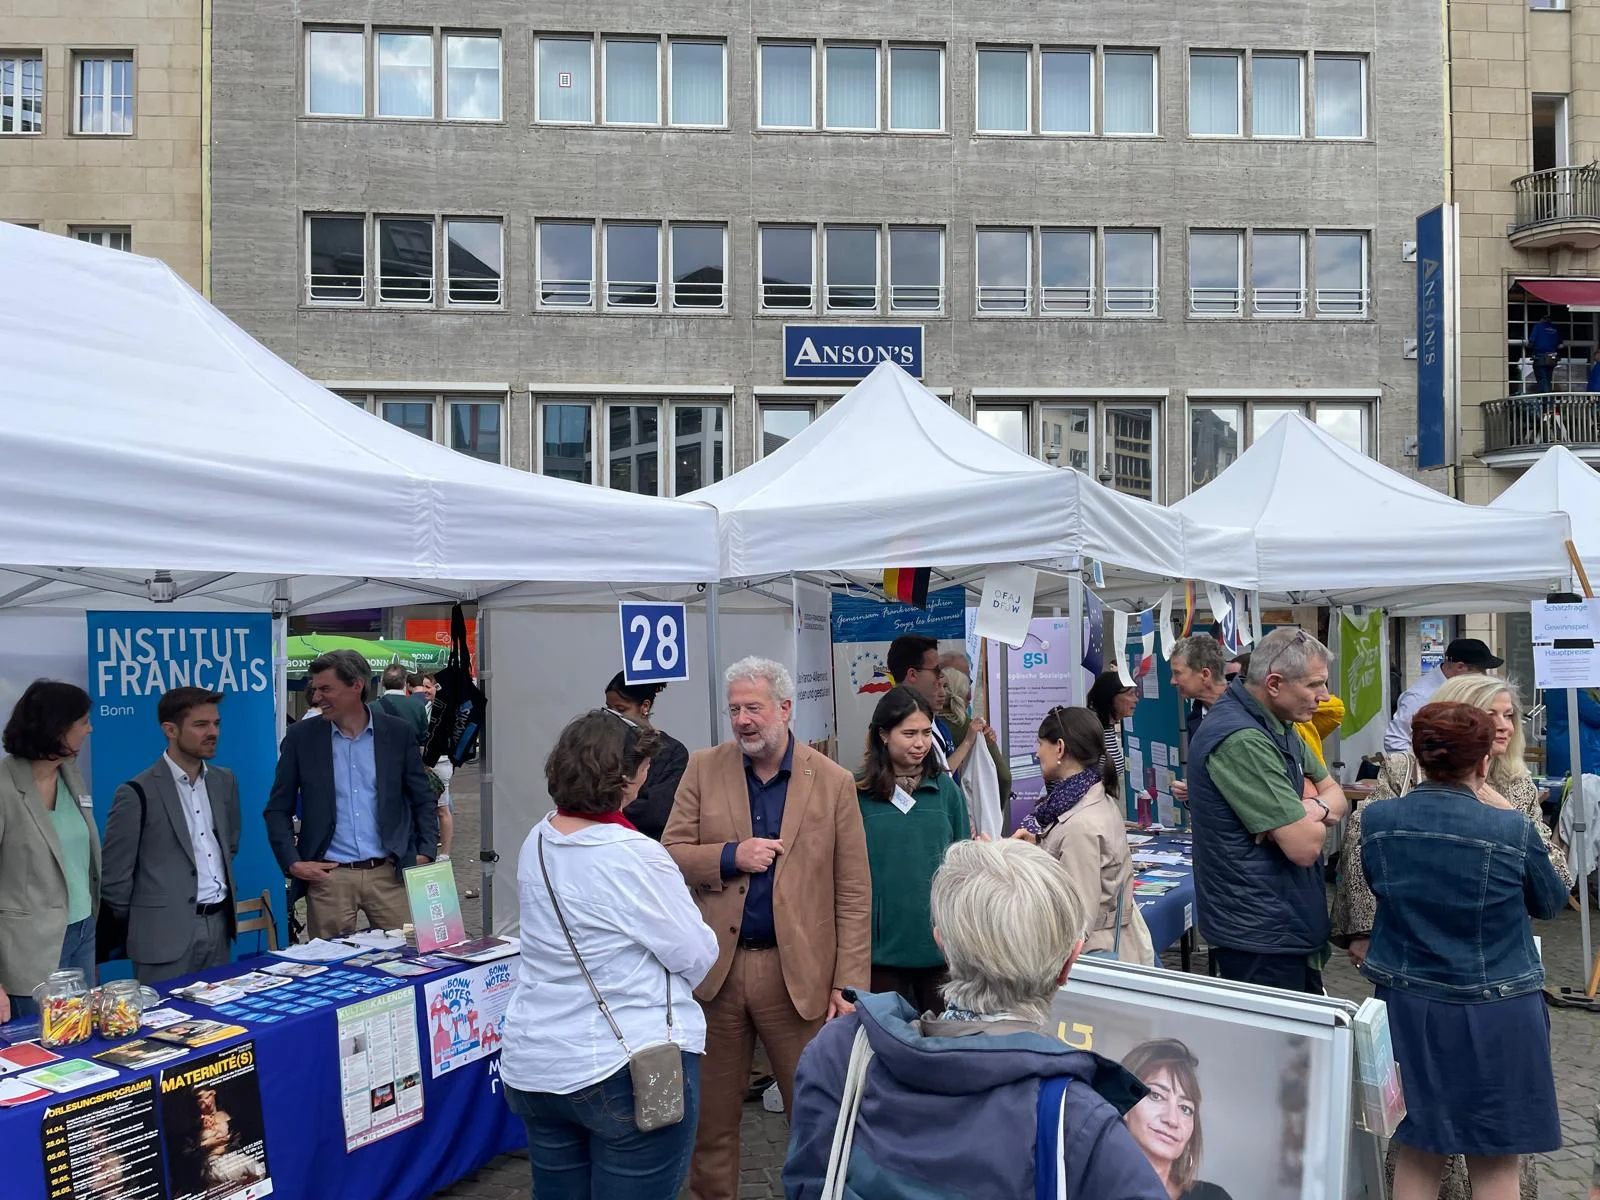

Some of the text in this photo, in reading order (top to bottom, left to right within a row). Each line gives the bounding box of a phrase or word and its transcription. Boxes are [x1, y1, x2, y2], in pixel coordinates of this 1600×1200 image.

[97, 628, 249, 666] INSTITUT
[630, 614, 679, 671] 28
[1023, 652, 1048, 669] gsi
[100, 705, 134, 717] Bonn
[161, 1051, 253, 1093] MATERNITÉ(S)
[48, 1080, 152, 1118] ORLESUNGSPROGRAMM
